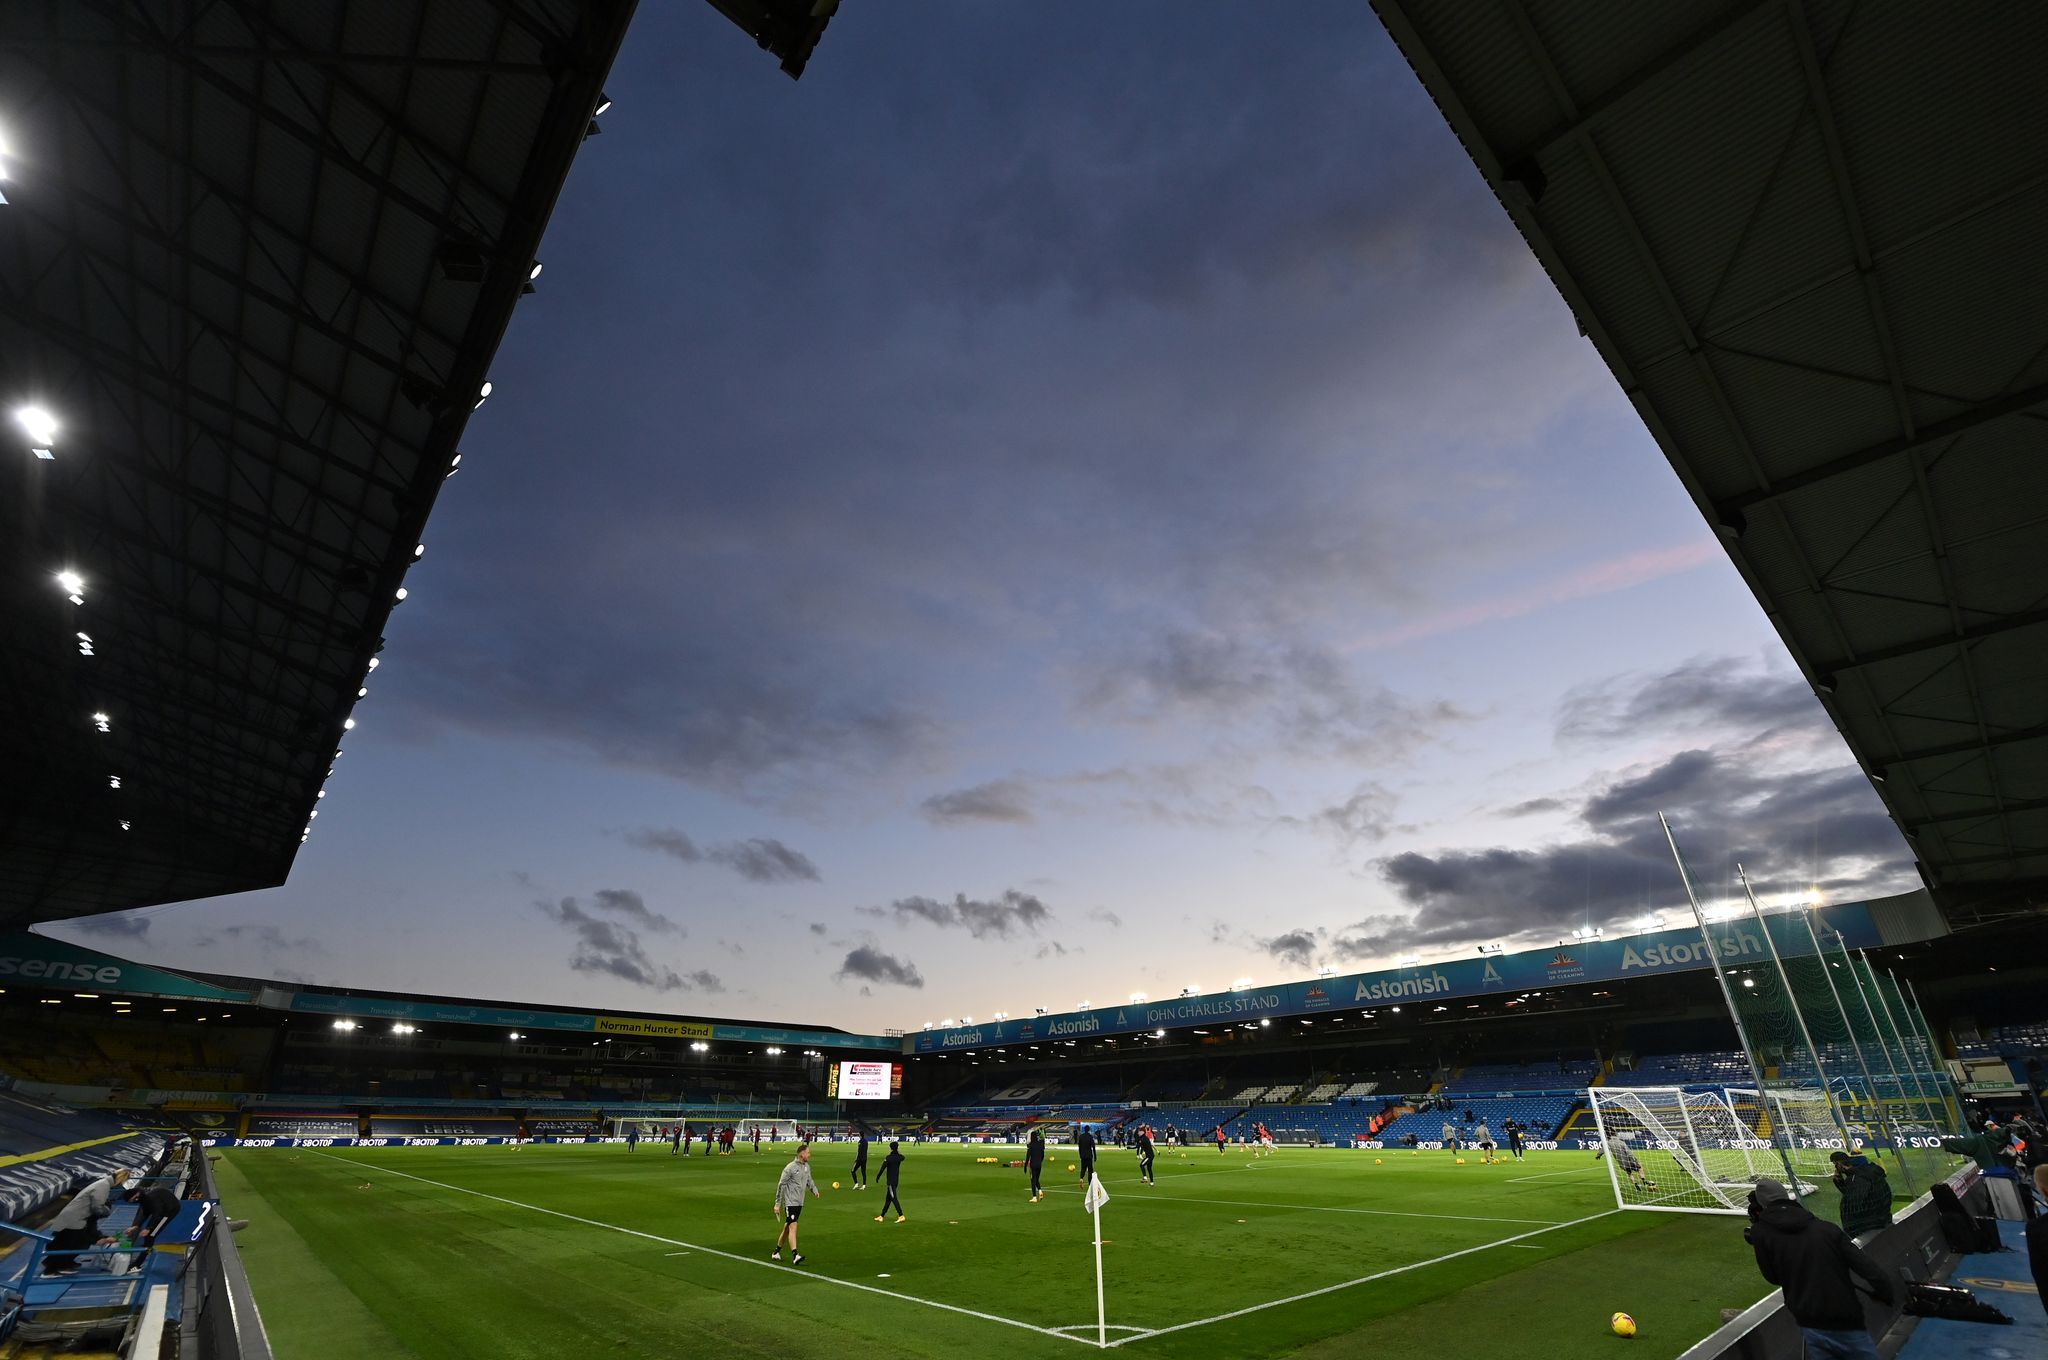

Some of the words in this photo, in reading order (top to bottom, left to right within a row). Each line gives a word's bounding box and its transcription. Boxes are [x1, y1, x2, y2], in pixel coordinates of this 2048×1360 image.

[0, 957, 121, 984] sense
[1355, 970, 1449, 1001] Astonish
[1147, 1008, 1175, 1024] JOHN
[1178, 1000, 1232, 1018] CHARLES
[1235, 994, 1280, 1012] STAND
[600, 1020, 641, 1032] Norman
[644, 1024, 678, 1035] Hunter
[681, 1026, 709, 1036] Stand
[1048, 1014, 1099, 1035] Astonish
[942, 1029, 982, 1046] Astonish
[243, 1139, 276, 1147] SBOTOP
[302, 1139, 334, 1147] SBOTOP
[411, 1138, 439, 1146] SBOTOP
[1358, 1141, 1383, 1149] SBOTOP
[1417, 1141, 1443, 1149] SBOTOP
[1526, 1140, 1558, 1150] SBOTOP
